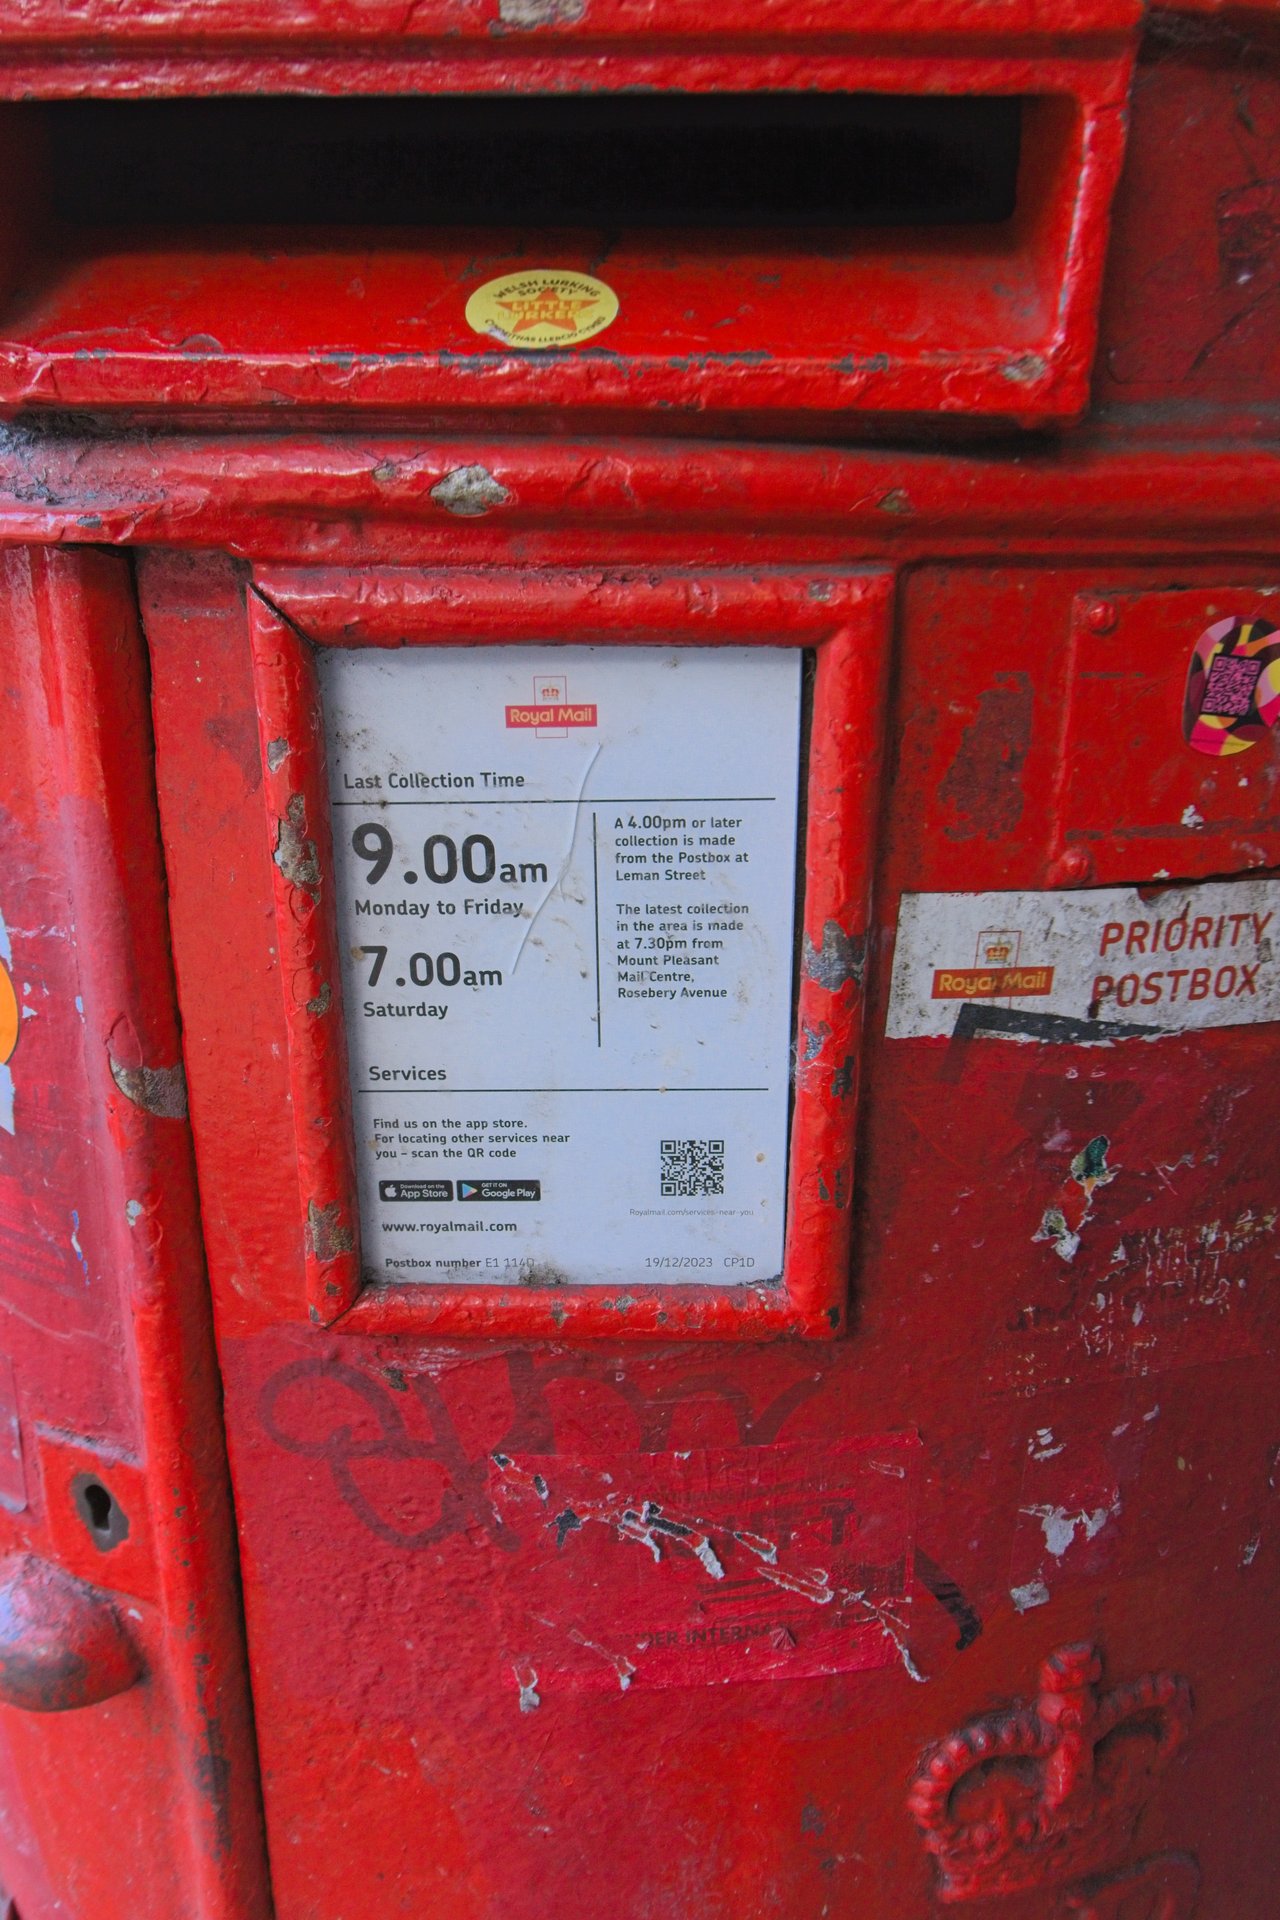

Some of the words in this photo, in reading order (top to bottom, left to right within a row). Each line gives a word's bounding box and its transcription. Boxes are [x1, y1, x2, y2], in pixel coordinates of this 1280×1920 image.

[493, 280, 538, 299] WELSH
[542, 279, 600, 297] LURKING
[510, 708, 554, 726] Royal
[558, 707, 592, 723] Mail
[344, 774, 382, 789] Last
[388, 772, 475, 788] Collection
[480, 772, 525, 788] Time
[614, 817, 623, 829] A
[628, 815, 686, 831] 4.00pm
[692, 819, 706, 828] or
[711, 817, 742, 828] later
[615, 835, 678, 847] collection
[683, 835, 694, 846] is
[699, 834, 736, 846] made
[351, 822, 549, 885] 9.00am
[615, 852, 647, 864] from
[652, 852, 674, 863] the
[679, 852, 730, 863] Postbox
[735, 852, 749, 863] at
[616, 870, 660, 881] Leman
[665, 869, 706, 881] Street
[355, 899, 430, 918] Monday
[437, 900, 456, 916] to
[464, 899, 523, 918] Friday
[616, 904, 640, 915] The
[645, 903, 683, 915] latest
[687, 903, 749, 914] collection
[616, 921, 628, 931] in
[633, 921, 654, 931] the
[659, 922, 688, 931] area
[692, 920, 703, 931] is
[708, 920, 744, 931] made
[1100, 912, 1273, 956] PRIORITY
[617, 939, 630, 950] at
[634, 937, 687, 951] 7.30pm
[692, 938, 723, 949] from
[360, 946, 502, 988] 7.00am
[617, 955, 659, 966] Mount
[663, 955, 719, 966] Pleasant
[618, 971, 644, 982] Mail
[650, 971, 695, 983] Centre,
[1002, 971, 1047, 990] Mail
[1091, 963, 1261, 1008] POSTBOX
[618, 987, 676, 1000] Rosebery
[681, 987, 728, 998] Avenue
[363, 1002, 448, 1021] Saturday
[368, 1066, 447, 1081] Services
[373, 1118, 399, 1129] Find
[404, 1120, 418, 1129] us
[422, 1120, 437, 1129] on
[441, 1119, 461, 1128] the
[466, 1120, 488, 1130] app
[492, 1119, 527, 1128] store.
[374, 1134, 394, 1144] For
[398, 1133, 447, 1145] locating
[451, 1133, 483, 1143] other
[488, 1133, 538, 1143] services
[543, 1134, 570, 1143] near
[375, 1150, 397, 1160] you
[411, 1150, 439, 1158] scan
[443, 1149, 463, 1158] the
[467, 1149, 484, 1159] QR
[489, 1148, 517, 1158] code
[400, 1189, 421, 1200] App
[422, 1189, 449, 1198] Store
[481, 1188, 515, 1200] Google
[516, 1188, 536, 1200] Play
[382, 1221, 517, 1234] www.royalmail.com
[385, 1258, 431, 1268] Postbox
[435, 1257, 481, 1268] number
[485, 1258, 499, 1268] E1
[645, 1257, 713, 1268] 19/12/2023
[723, 1257, 755, 1268] CP1D
